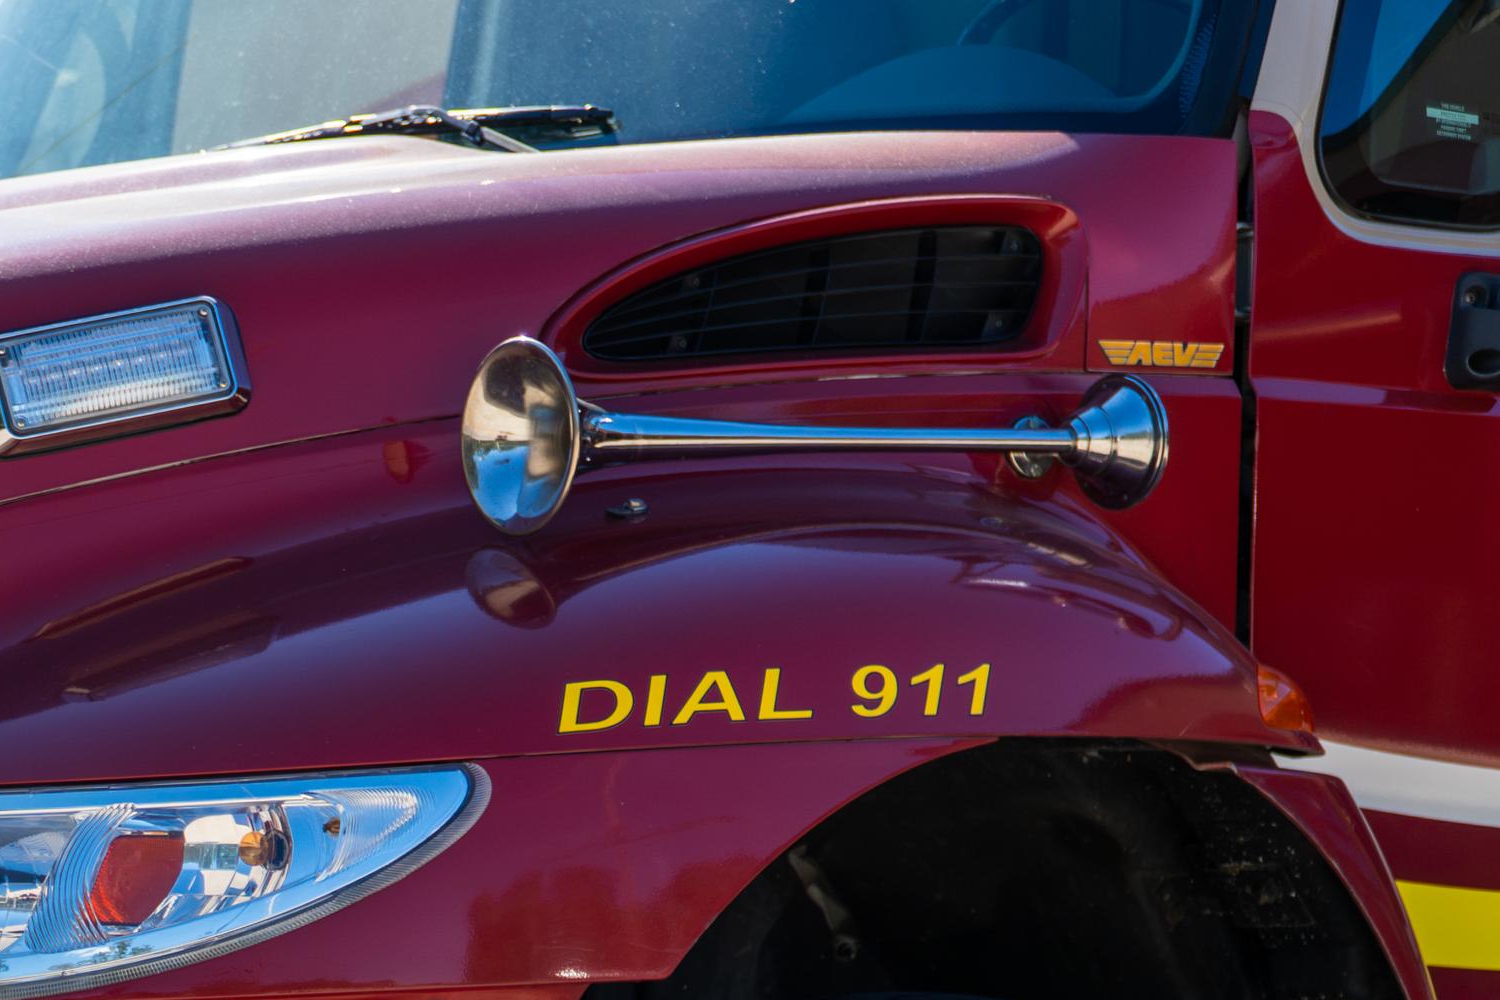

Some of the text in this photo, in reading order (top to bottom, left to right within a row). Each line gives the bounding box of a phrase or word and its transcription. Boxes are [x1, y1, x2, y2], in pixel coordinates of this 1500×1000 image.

[1125, 339, 1200, 367] AEV
[556, 662, 992, 735] DIAL 911
